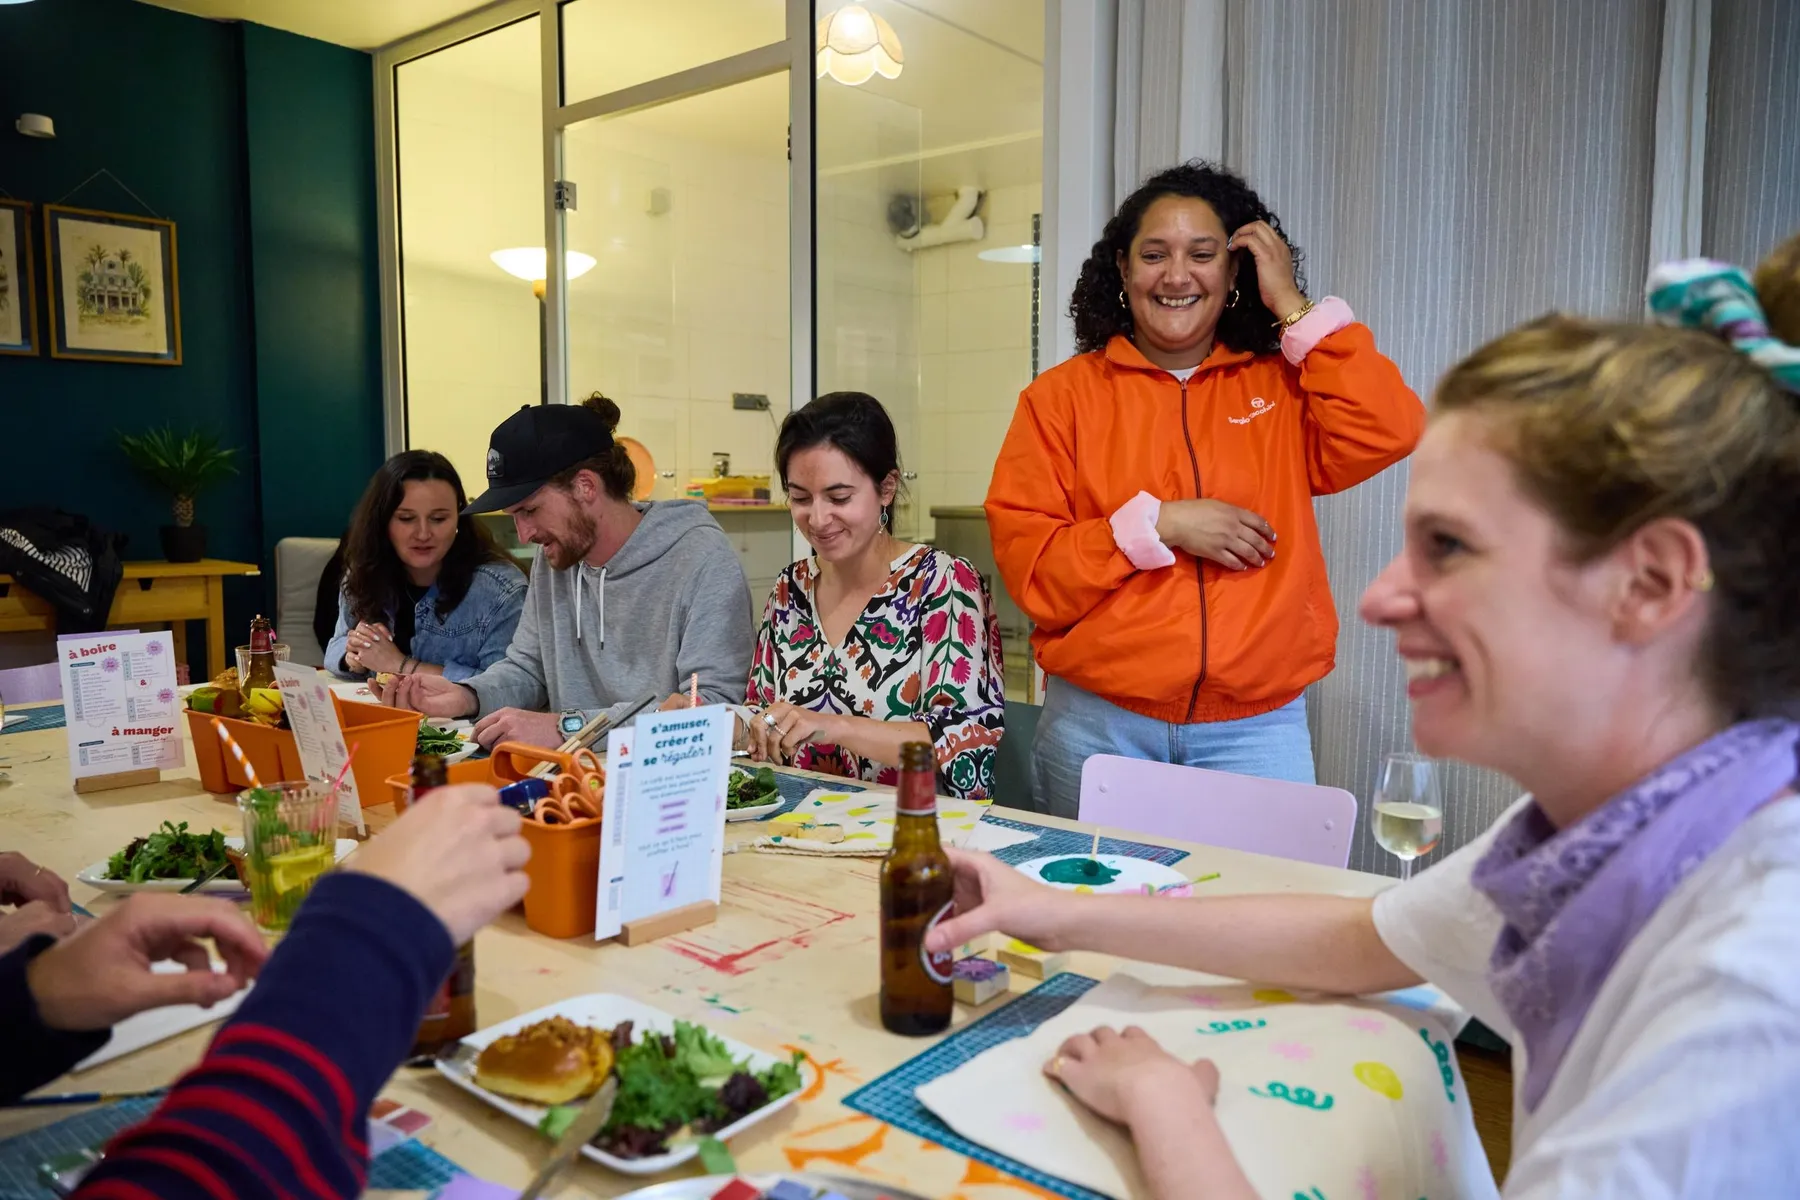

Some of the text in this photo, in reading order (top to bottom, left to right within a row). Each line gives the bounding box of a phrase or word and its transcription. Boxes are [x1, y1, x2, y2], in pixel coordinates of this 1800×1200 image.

[69, 643, 117, 659] à boire
[112, 725, 174, 736] à manger
[651, 718, 710, 734] s'amuser,
[655, 732, 704, 749] créer et
[620, 743, 628, 756] à
[643, 757, 657, 766] se
[661, 745, 705, 766] régaler
